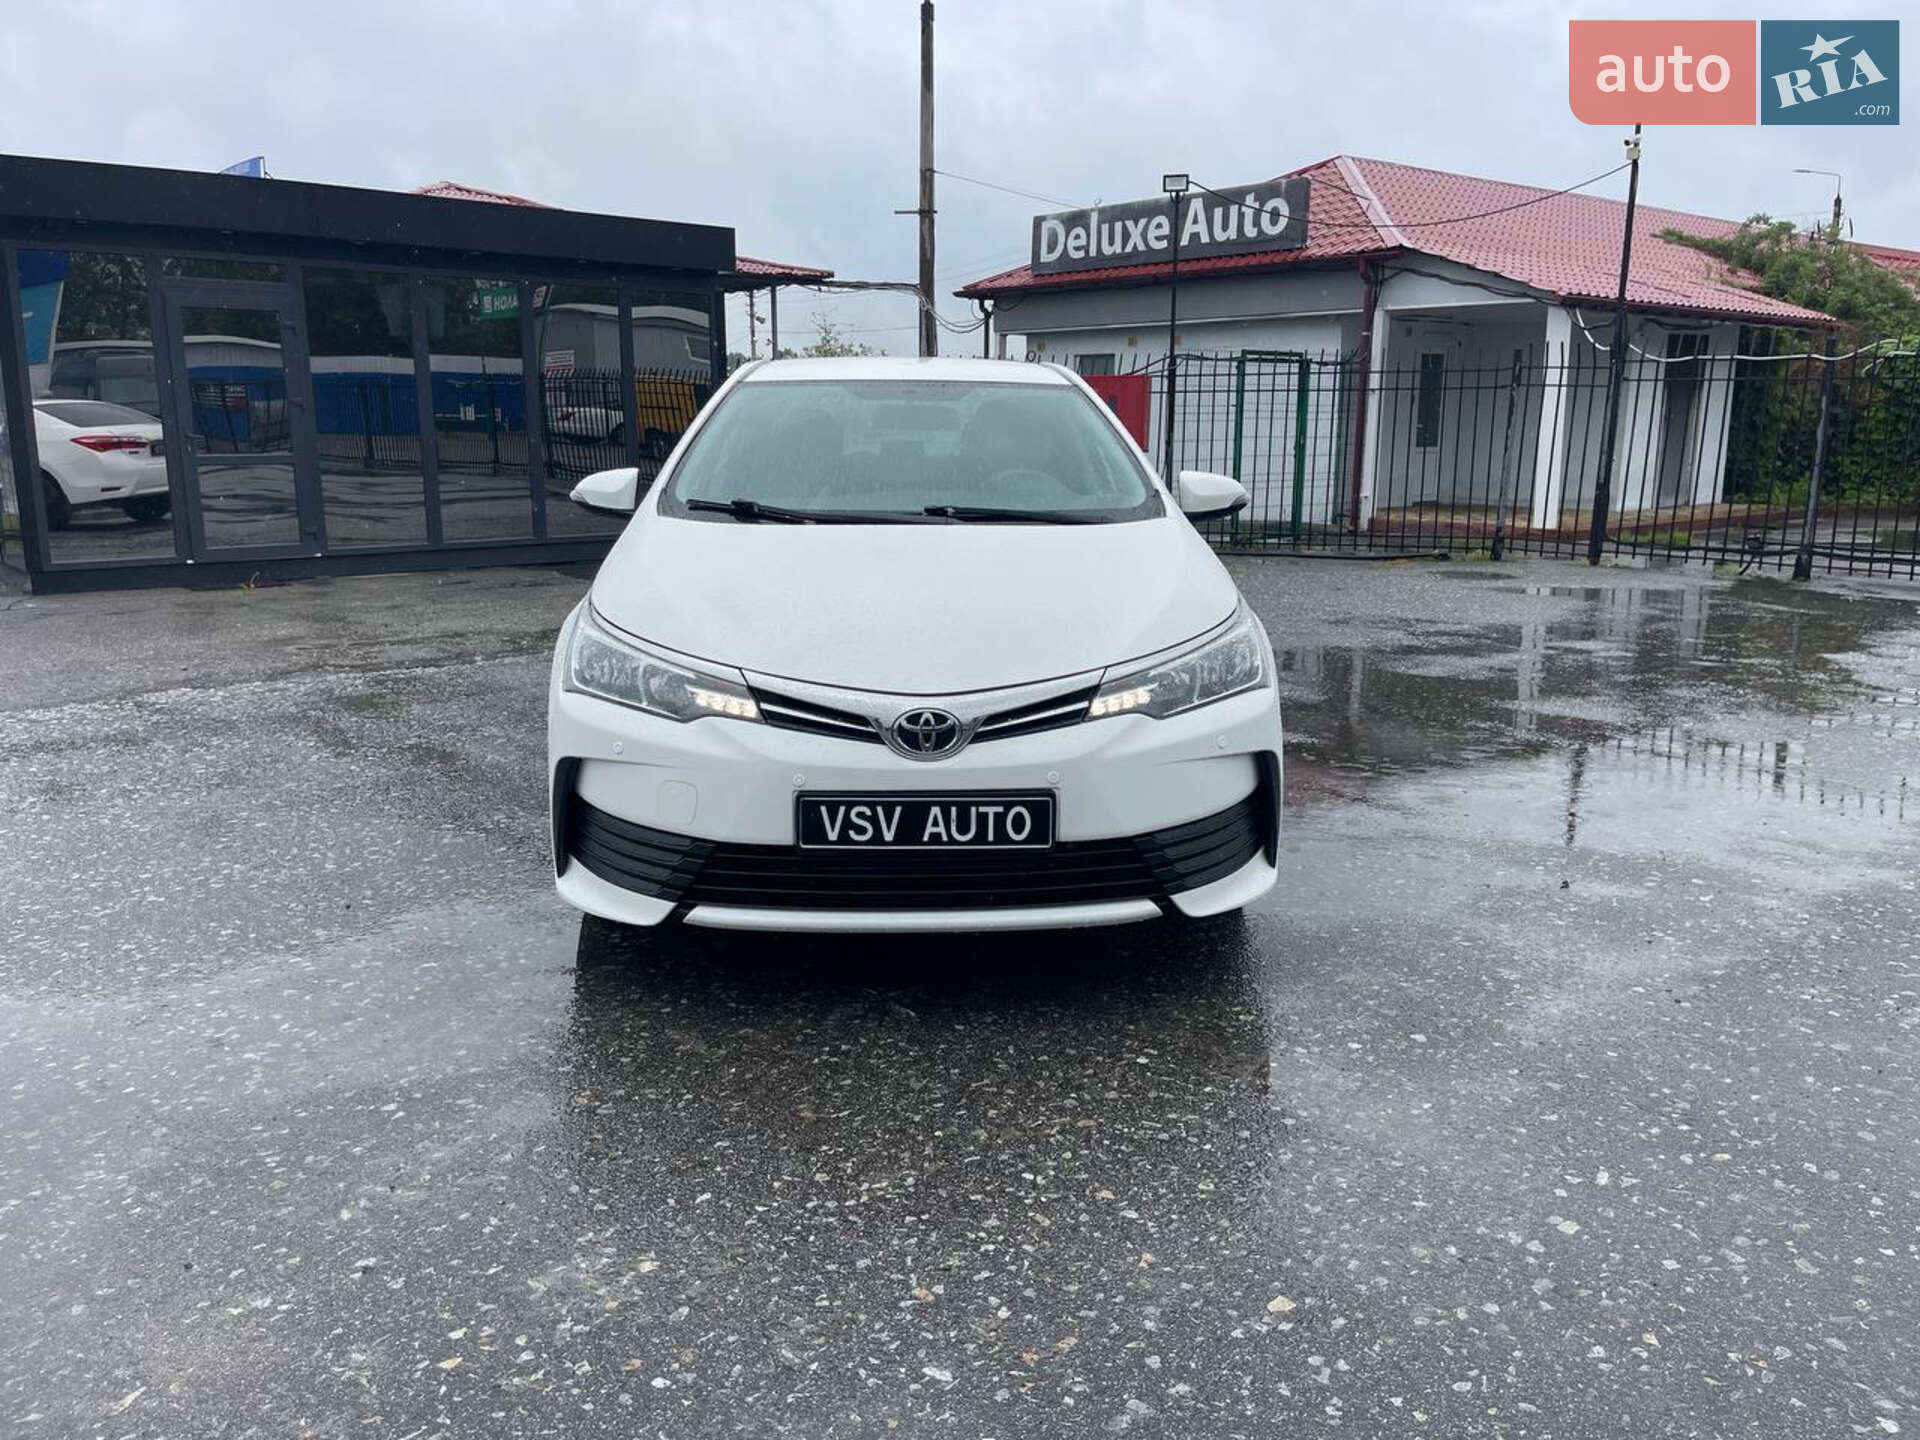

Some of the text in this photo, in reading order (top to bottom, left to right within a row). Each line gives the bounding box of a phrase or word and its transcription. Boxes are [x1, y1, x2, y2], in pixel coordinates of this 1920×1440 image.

[1039, 192, 1290, 263] Deluxe Auto
[820, 805, 1032, 842] VSV AUTO
